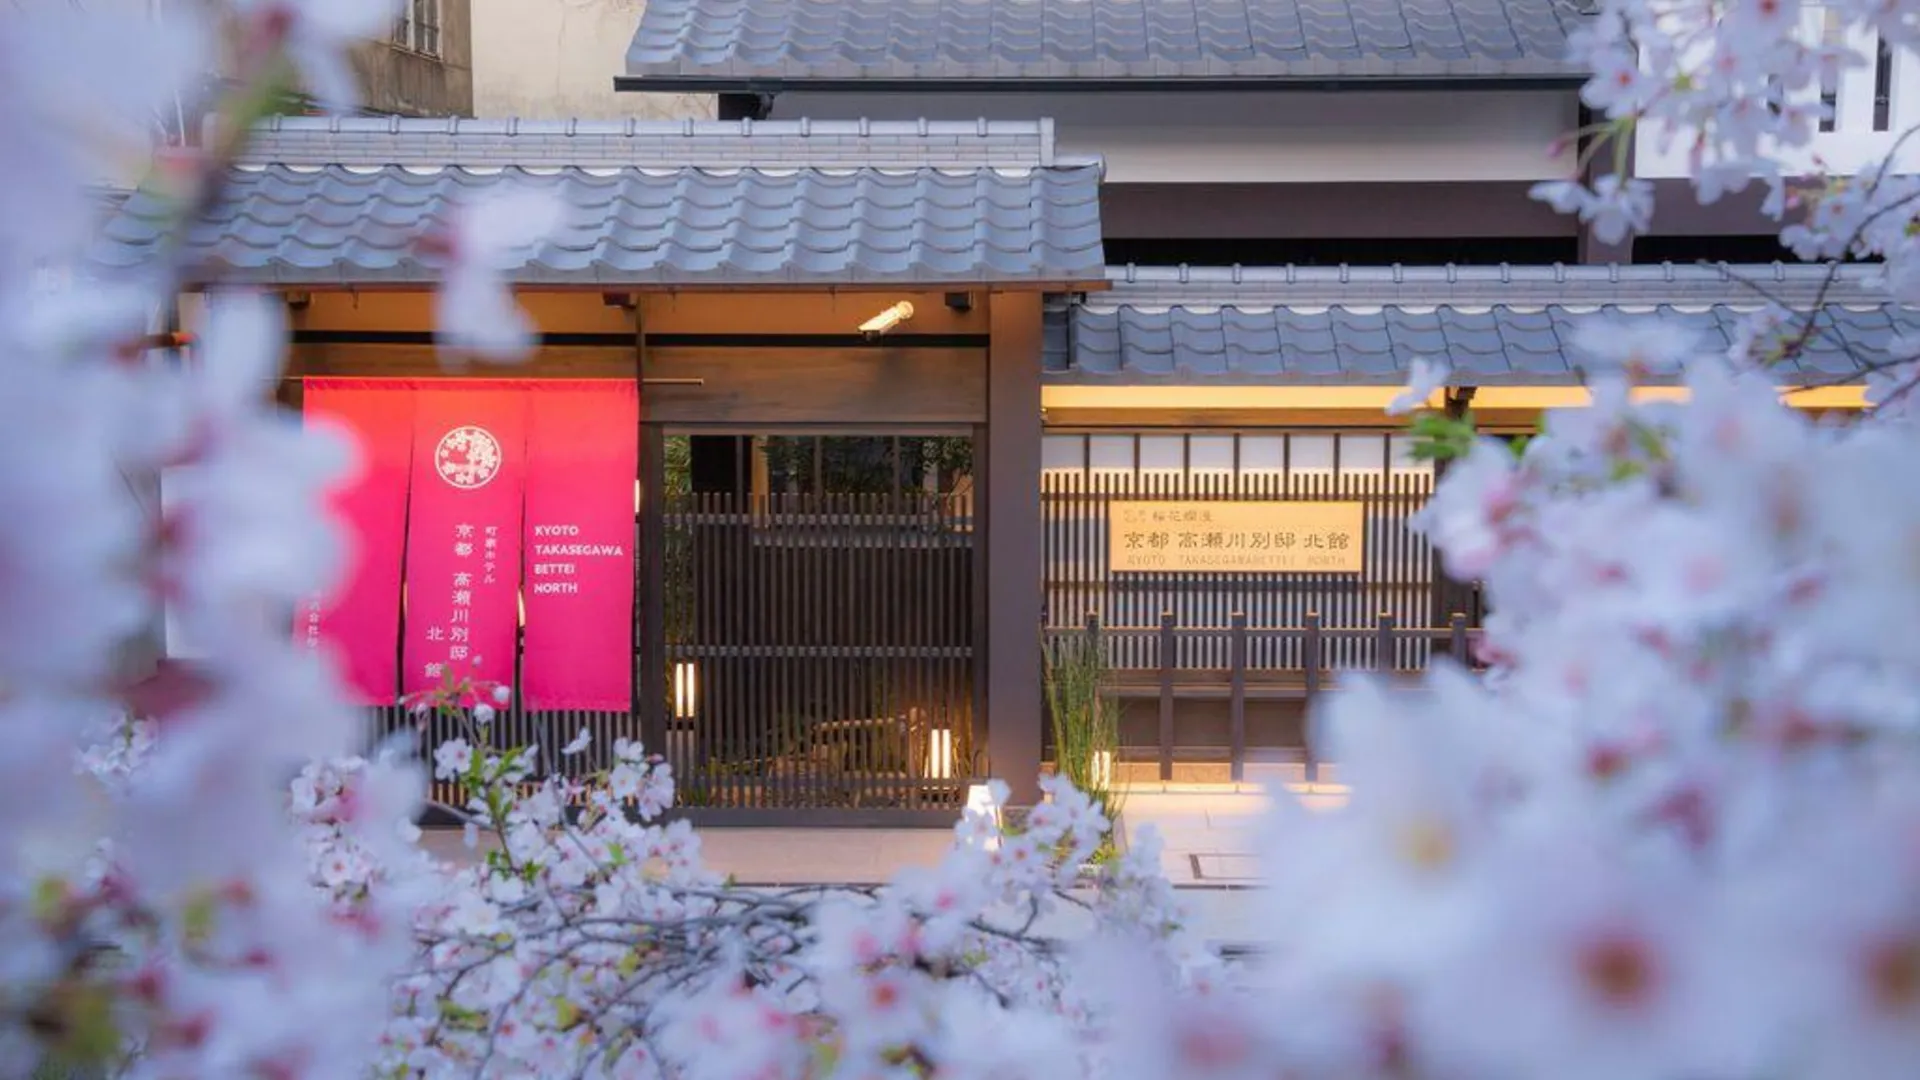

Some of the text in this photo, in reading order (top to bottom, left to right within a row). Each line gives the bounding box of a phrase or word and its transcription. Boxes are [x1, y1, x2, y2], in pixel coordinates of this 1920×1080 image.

[534, 525, 579, 536] KYOTO
[1124, 531, 1350, 549] 京都 高瀬川別邸 北館
[534, 544, 623, 556] TAKASEGAWA
[1127, 554, 1165, 566] KYOTO
[1306, 554, 1346, 566] NORTH
[534, 563, 574, 574] BETTEI
[449, 523, 473, 659] 京都 高瀬川別邸
[534, 582, 577, 594] NORTH
